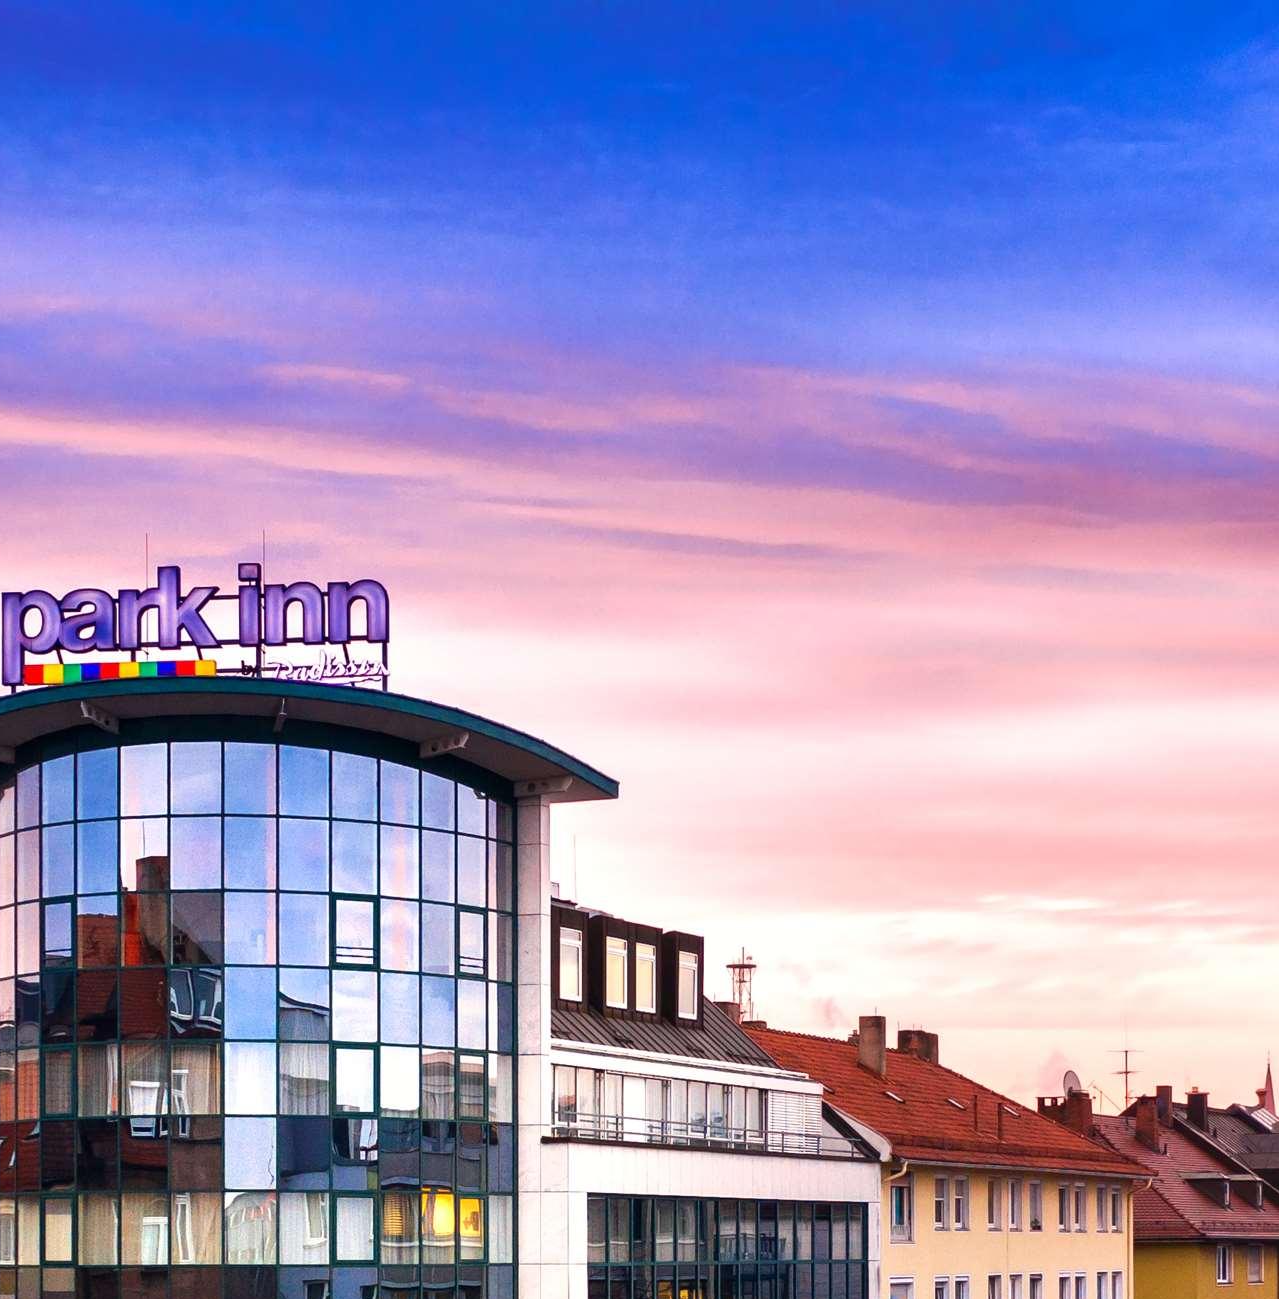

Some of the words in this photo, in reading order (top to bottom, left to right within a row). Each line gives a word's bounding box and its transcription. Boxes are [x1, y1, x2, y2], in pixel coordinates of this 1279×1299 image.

[2, 565, 221, 685] park
[238, 563, 390, 646] inn
[268, 650, 390, 682] Radisson
